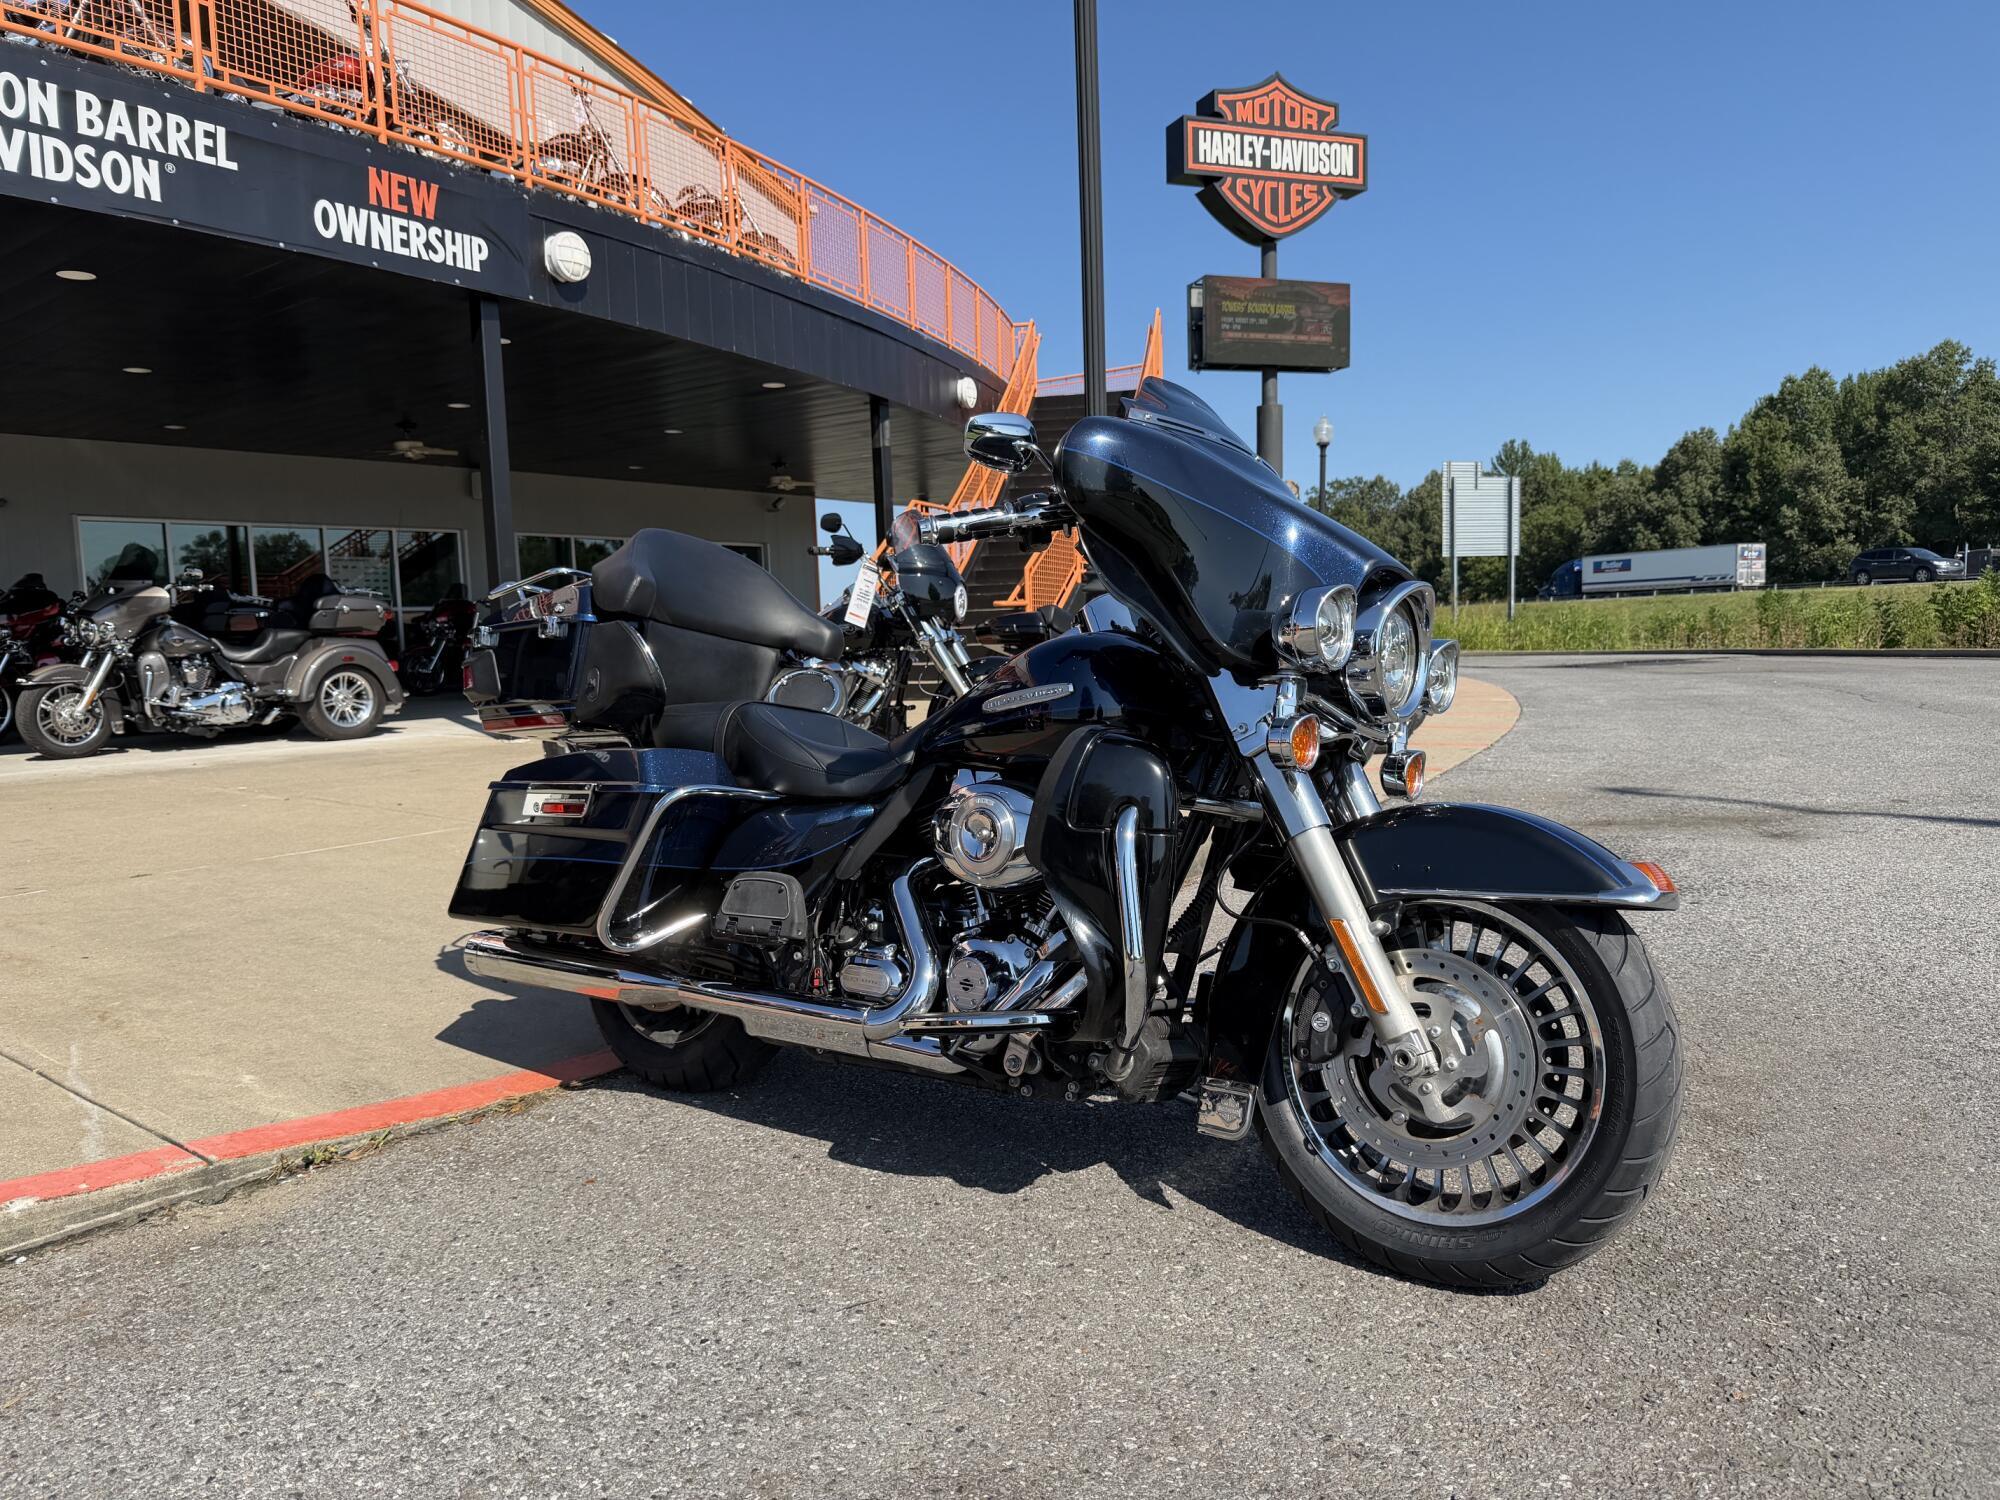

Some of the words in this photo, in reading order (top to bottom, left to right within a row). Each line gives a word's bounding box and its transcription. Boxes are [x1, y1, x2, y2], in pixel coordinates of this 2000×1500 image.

[0, 72, 60, 129] ON
[75, 89, 238, 171] BARREL
[1236, 90, 1318, 131] MOTOR
[1199, 129, 1354, 177] HARLEY-DAVIDSON
[368, 166, 439, 220] NEW
[1236, 178, 1319, 224] CYCLES
[314, 199, 489, 272] OWNERSHIP
[1372, 1218, 1476, 1249] SHINKO
